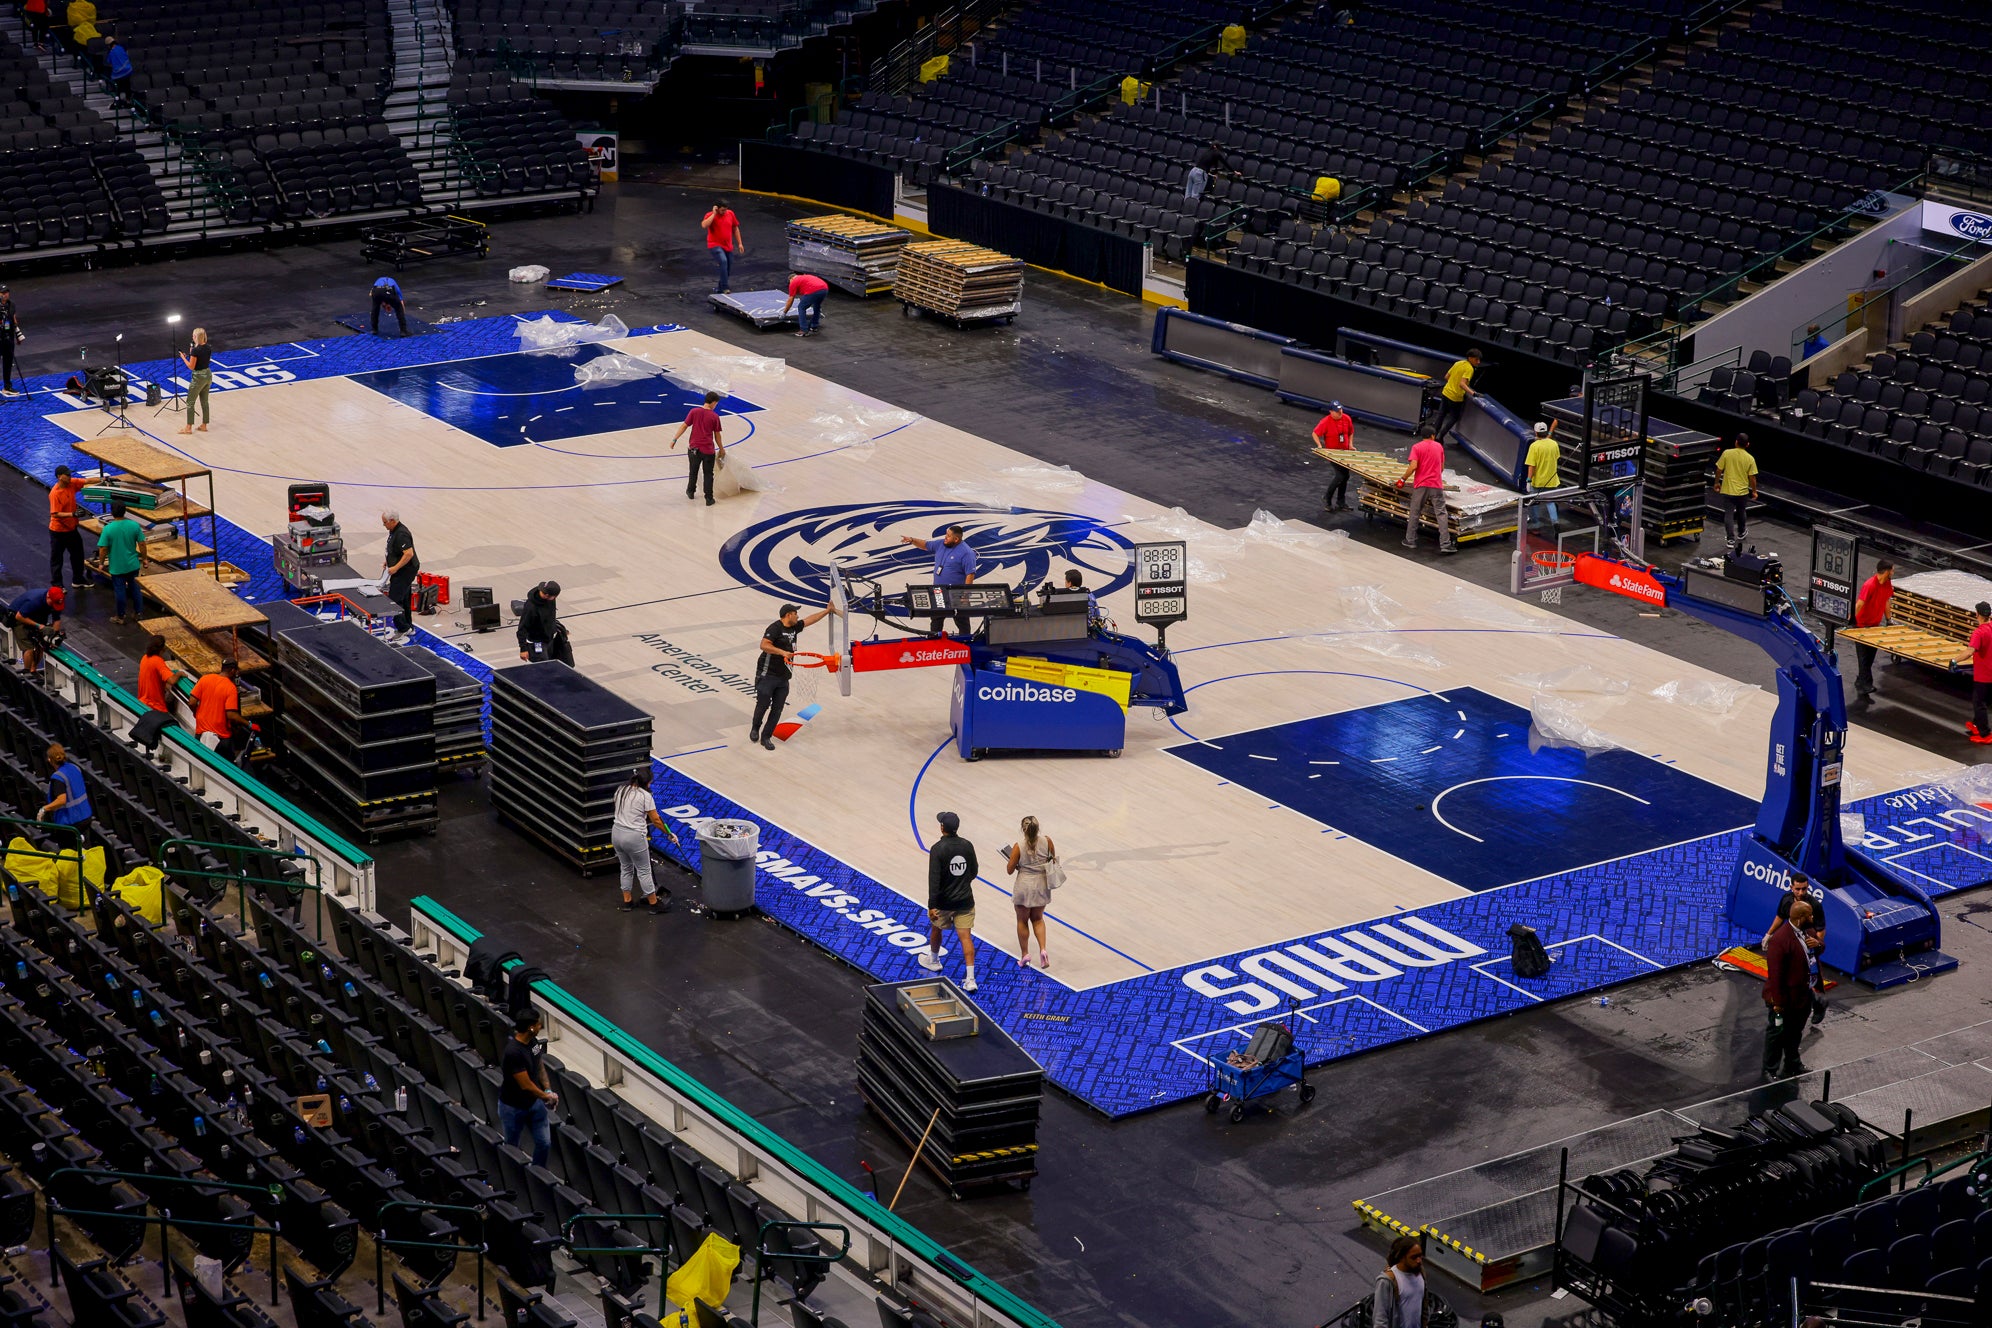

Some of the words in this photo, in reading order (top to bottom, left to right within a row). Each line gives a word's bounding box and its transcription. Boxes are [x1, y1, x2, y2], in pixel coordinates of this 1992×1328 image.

[1959, 215, 1992, 239] Ford
[1605, 446, 1641, 460] TISSOT
[1152, 586, 1183, 594] TISSOT
[1823, 580, 1849, 594] TISSOT
[632, 634, 722, 674] American
[651, 663, 719, 694] Center
[978, 682, 1077, 703] coinbase
[949, 862, 967, 871] TNT
[1023, 1013, 1045, 1021] KEITH
[1045, 1014, 1071, 1023] GRANT
[1026, 1022, 1046, 1030] SAM
[1047, 1024, 1083, 1033] PERKINS
[1022, 1034, 1049, 1043] DEVIN
[1050, 1037, 1084, 1046] HARRIS
[1098, 1075, 1127, 1084] SHAWN
